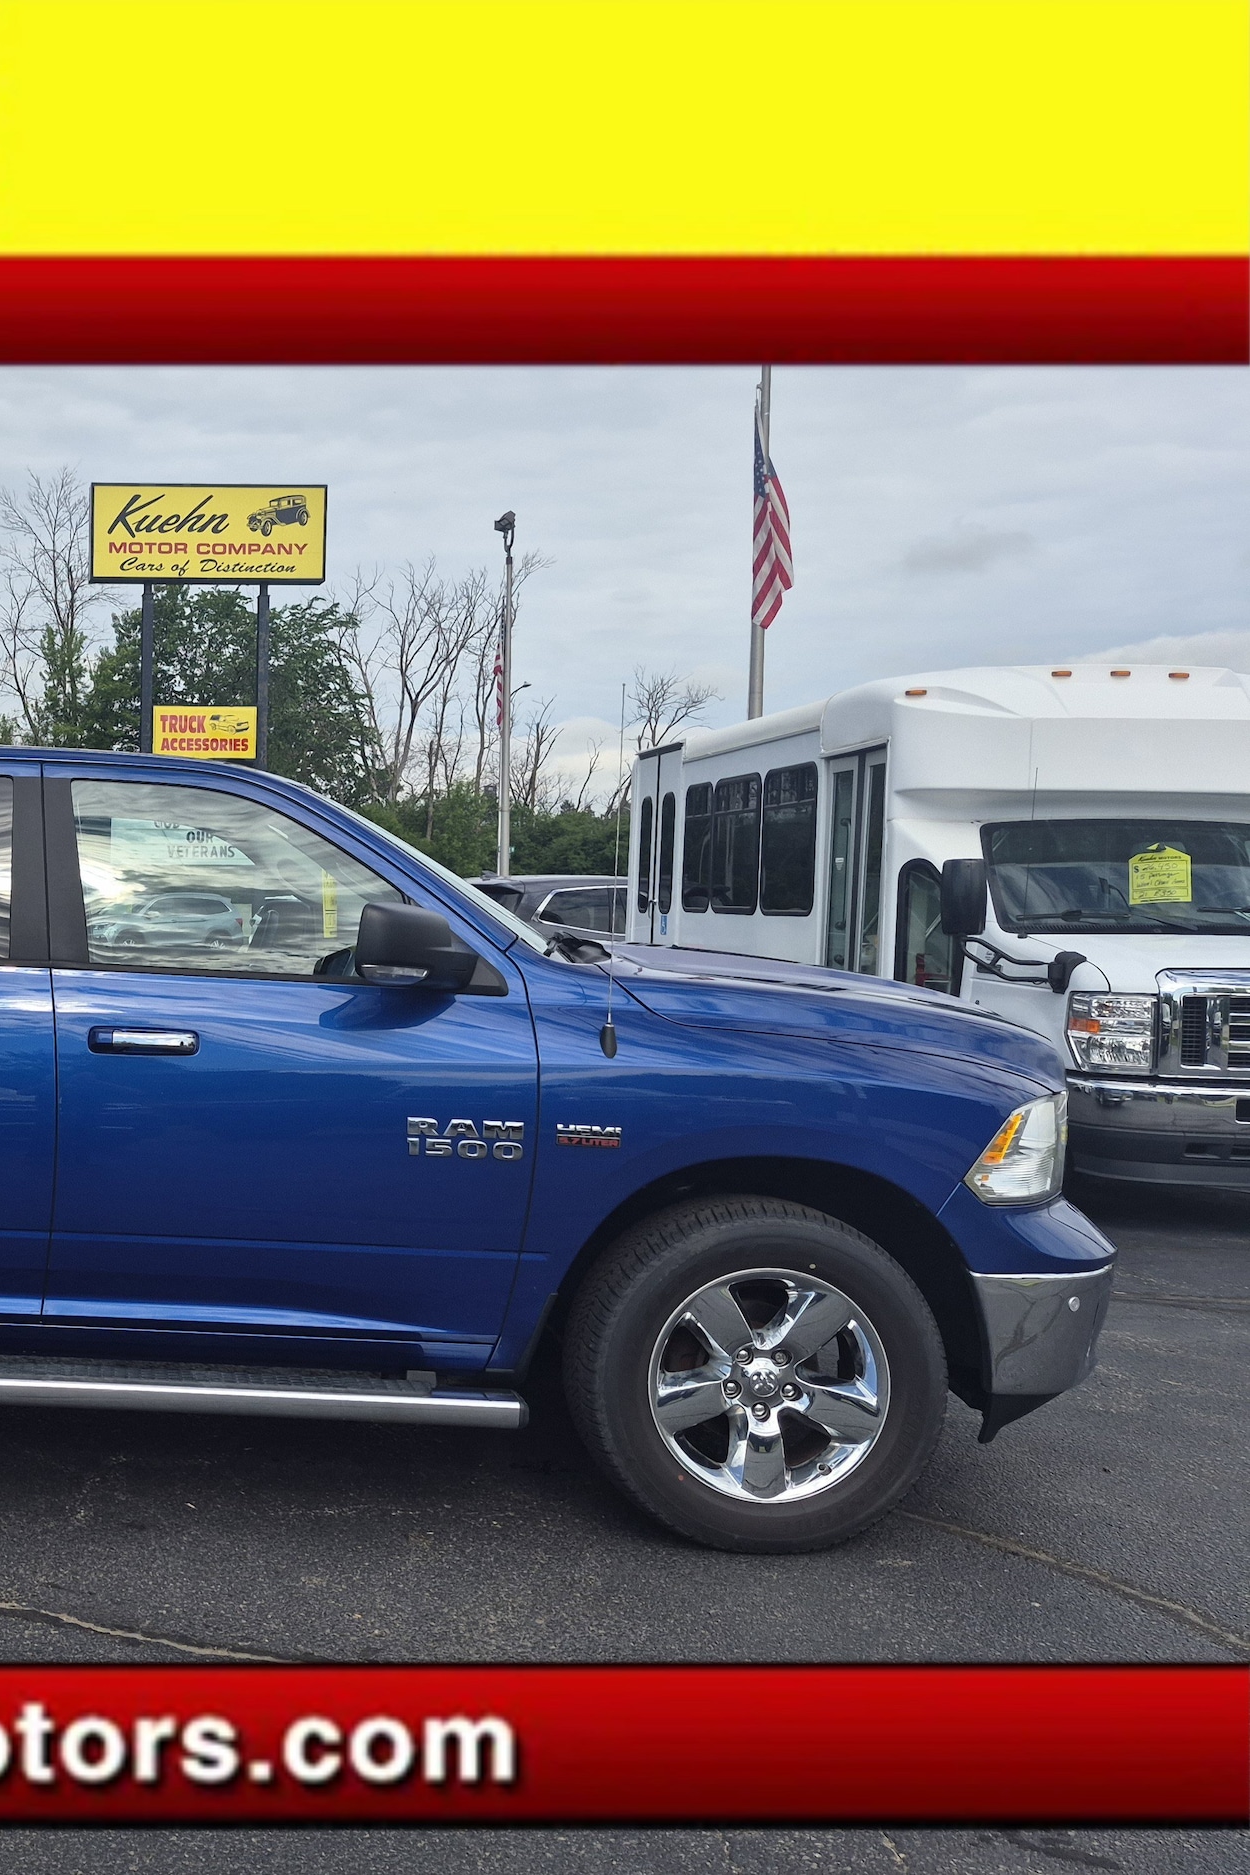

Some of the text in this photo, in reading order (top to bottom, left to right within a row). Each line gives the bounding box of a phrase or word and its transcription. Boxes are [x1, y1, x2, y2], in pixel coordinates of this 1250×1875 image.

[107, 493, 230, 538] Kuehn
[108, 542, 308, 555] MOTOR COMPANY
[119, 557, 296, 576] Cars of Distinction
[160, 715, 206, 733] TRUCK
[161, 738, 249, 752] ACCESSORIES
[186, 830, 214, 844] OUR
[167, 845, 236, 858] VETERANS
[407, 1116, 525, 1140] RAM
[556, 1123, 623, 1137] HEMI
[407, 1137, 524, 1161] 1500
[581, 1137, 619, 1147] LITER
